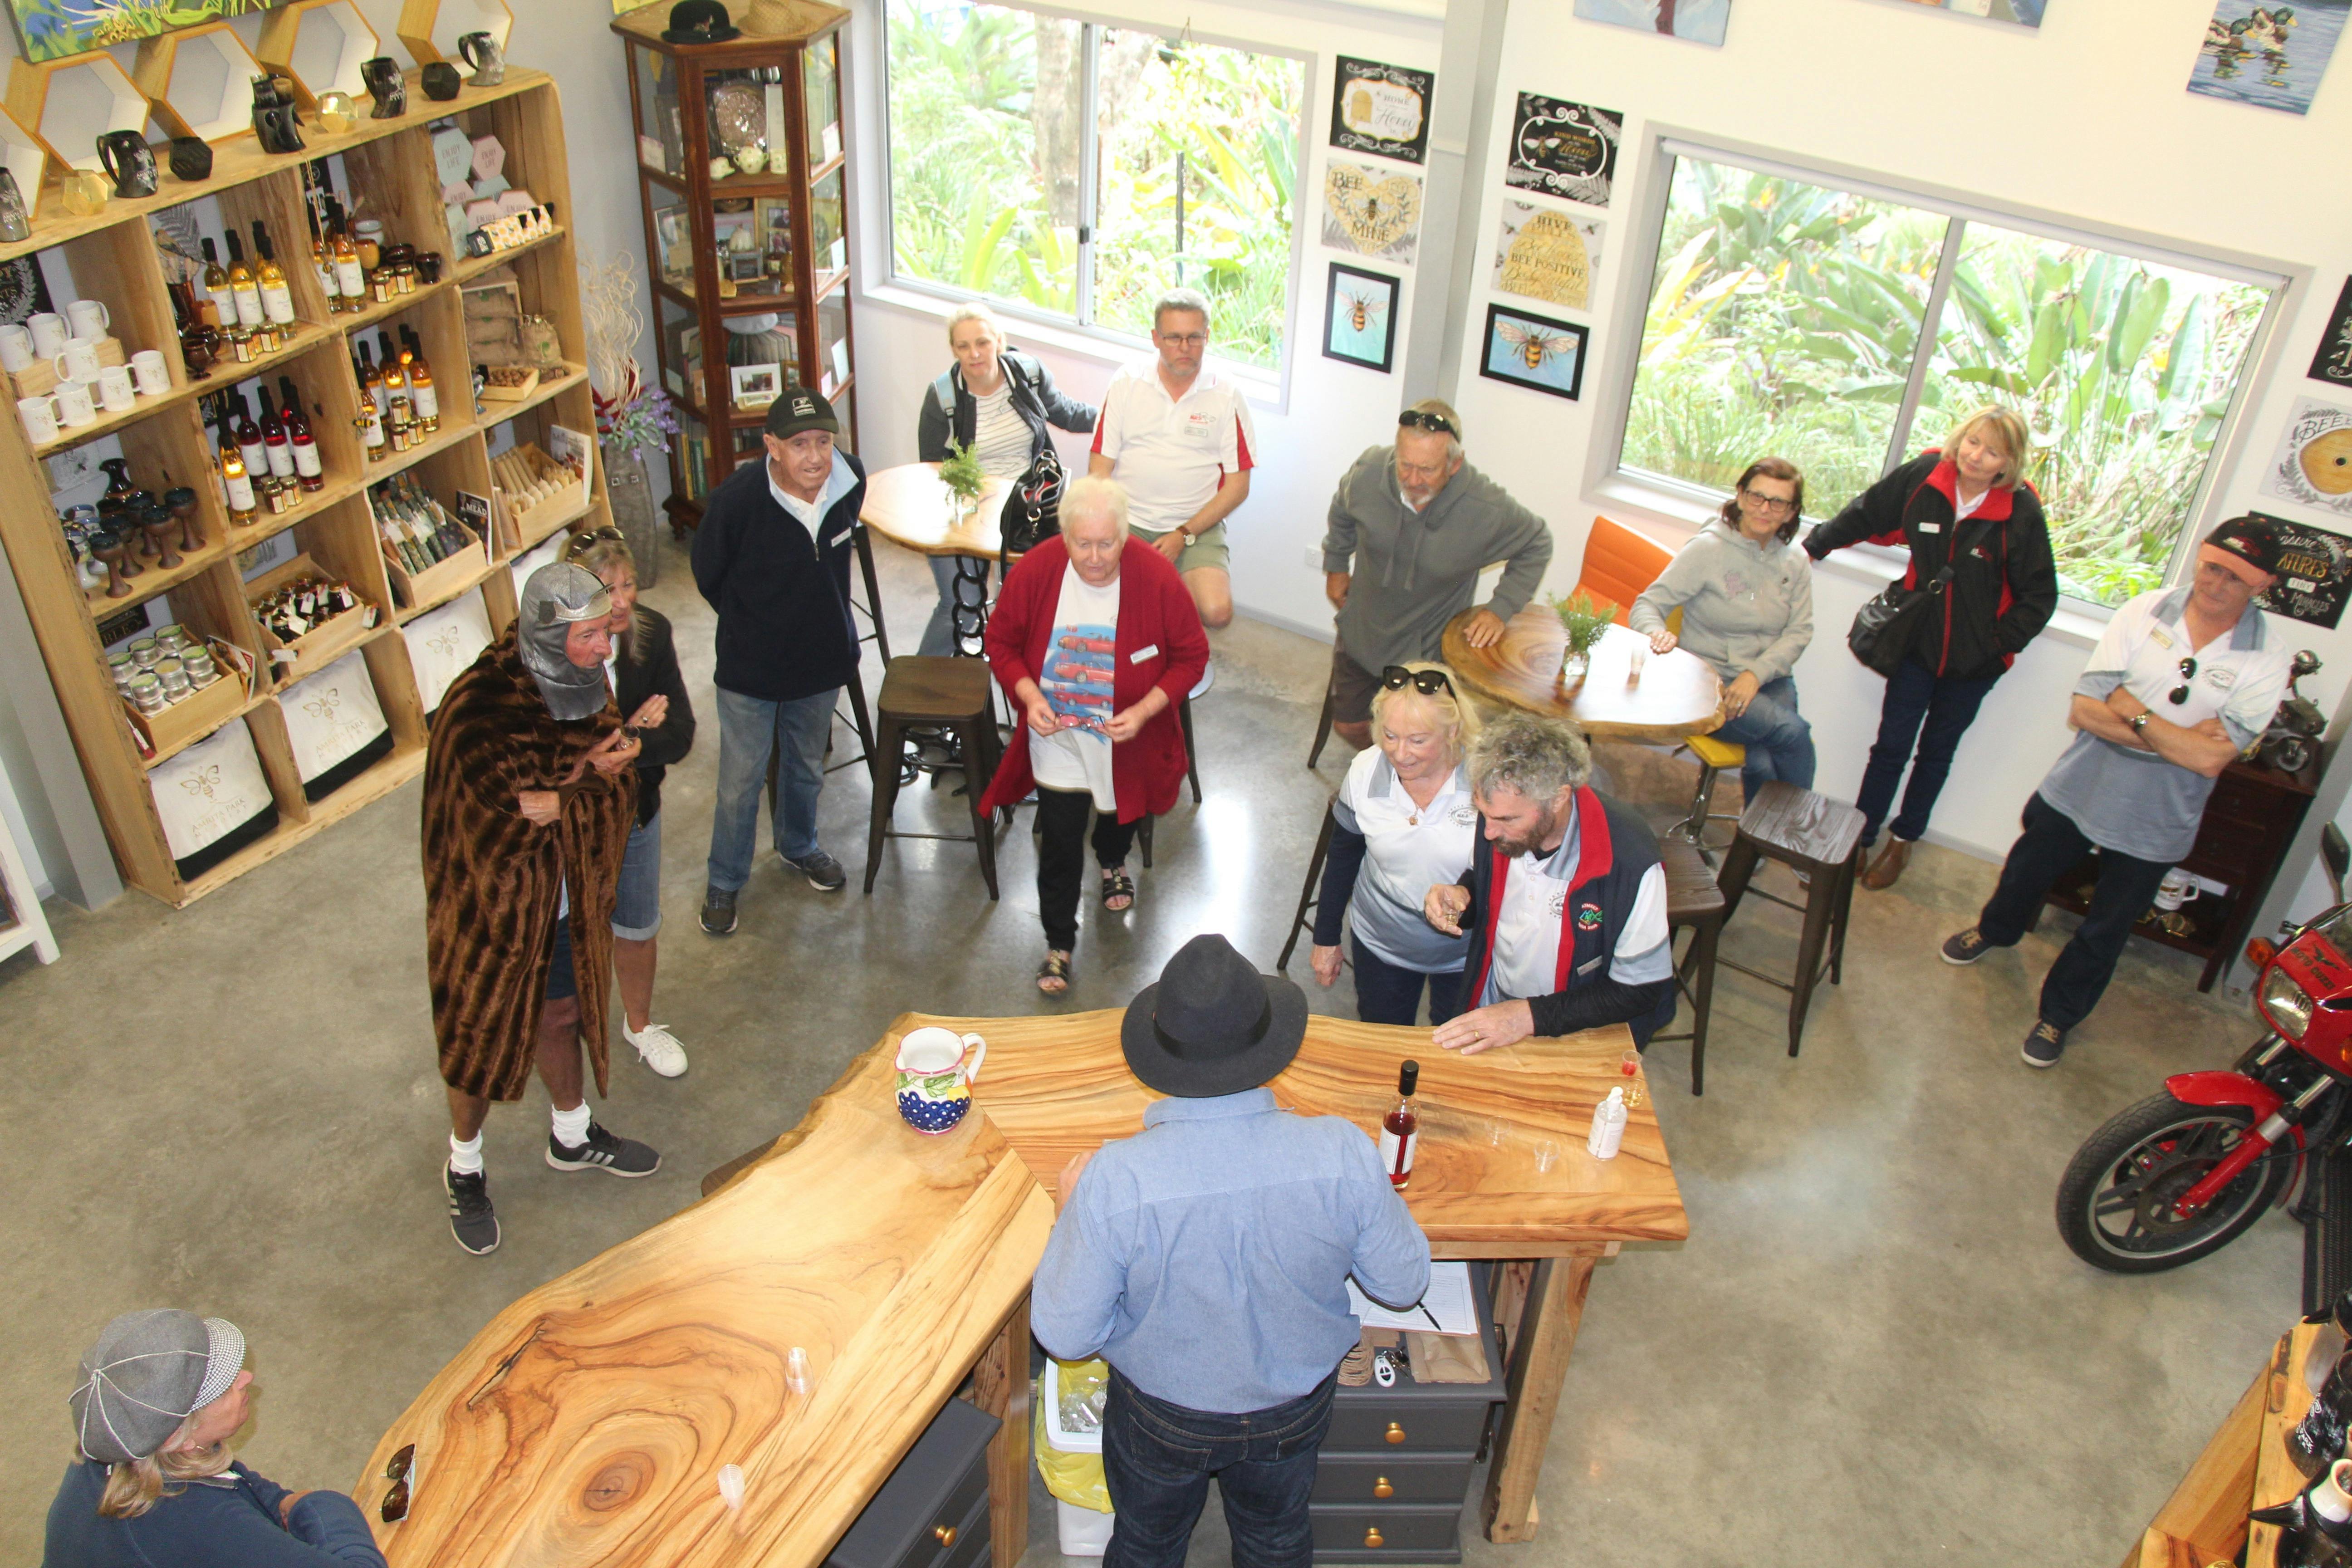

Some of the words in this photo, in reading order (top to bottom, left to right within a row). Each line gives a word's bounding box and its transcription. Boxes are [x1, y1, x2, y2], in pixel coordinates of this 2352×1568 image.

[1352, 221, 1390, 242] MINE
[1535, 257, 1585, 278] POSITIVE
[466, 502, 487, 516] MEAD
[2277, 553, 2330, 578] ATURES
[225, 799, 245, 812] PARK
[2290, 947, 2313, 966] MOTO
